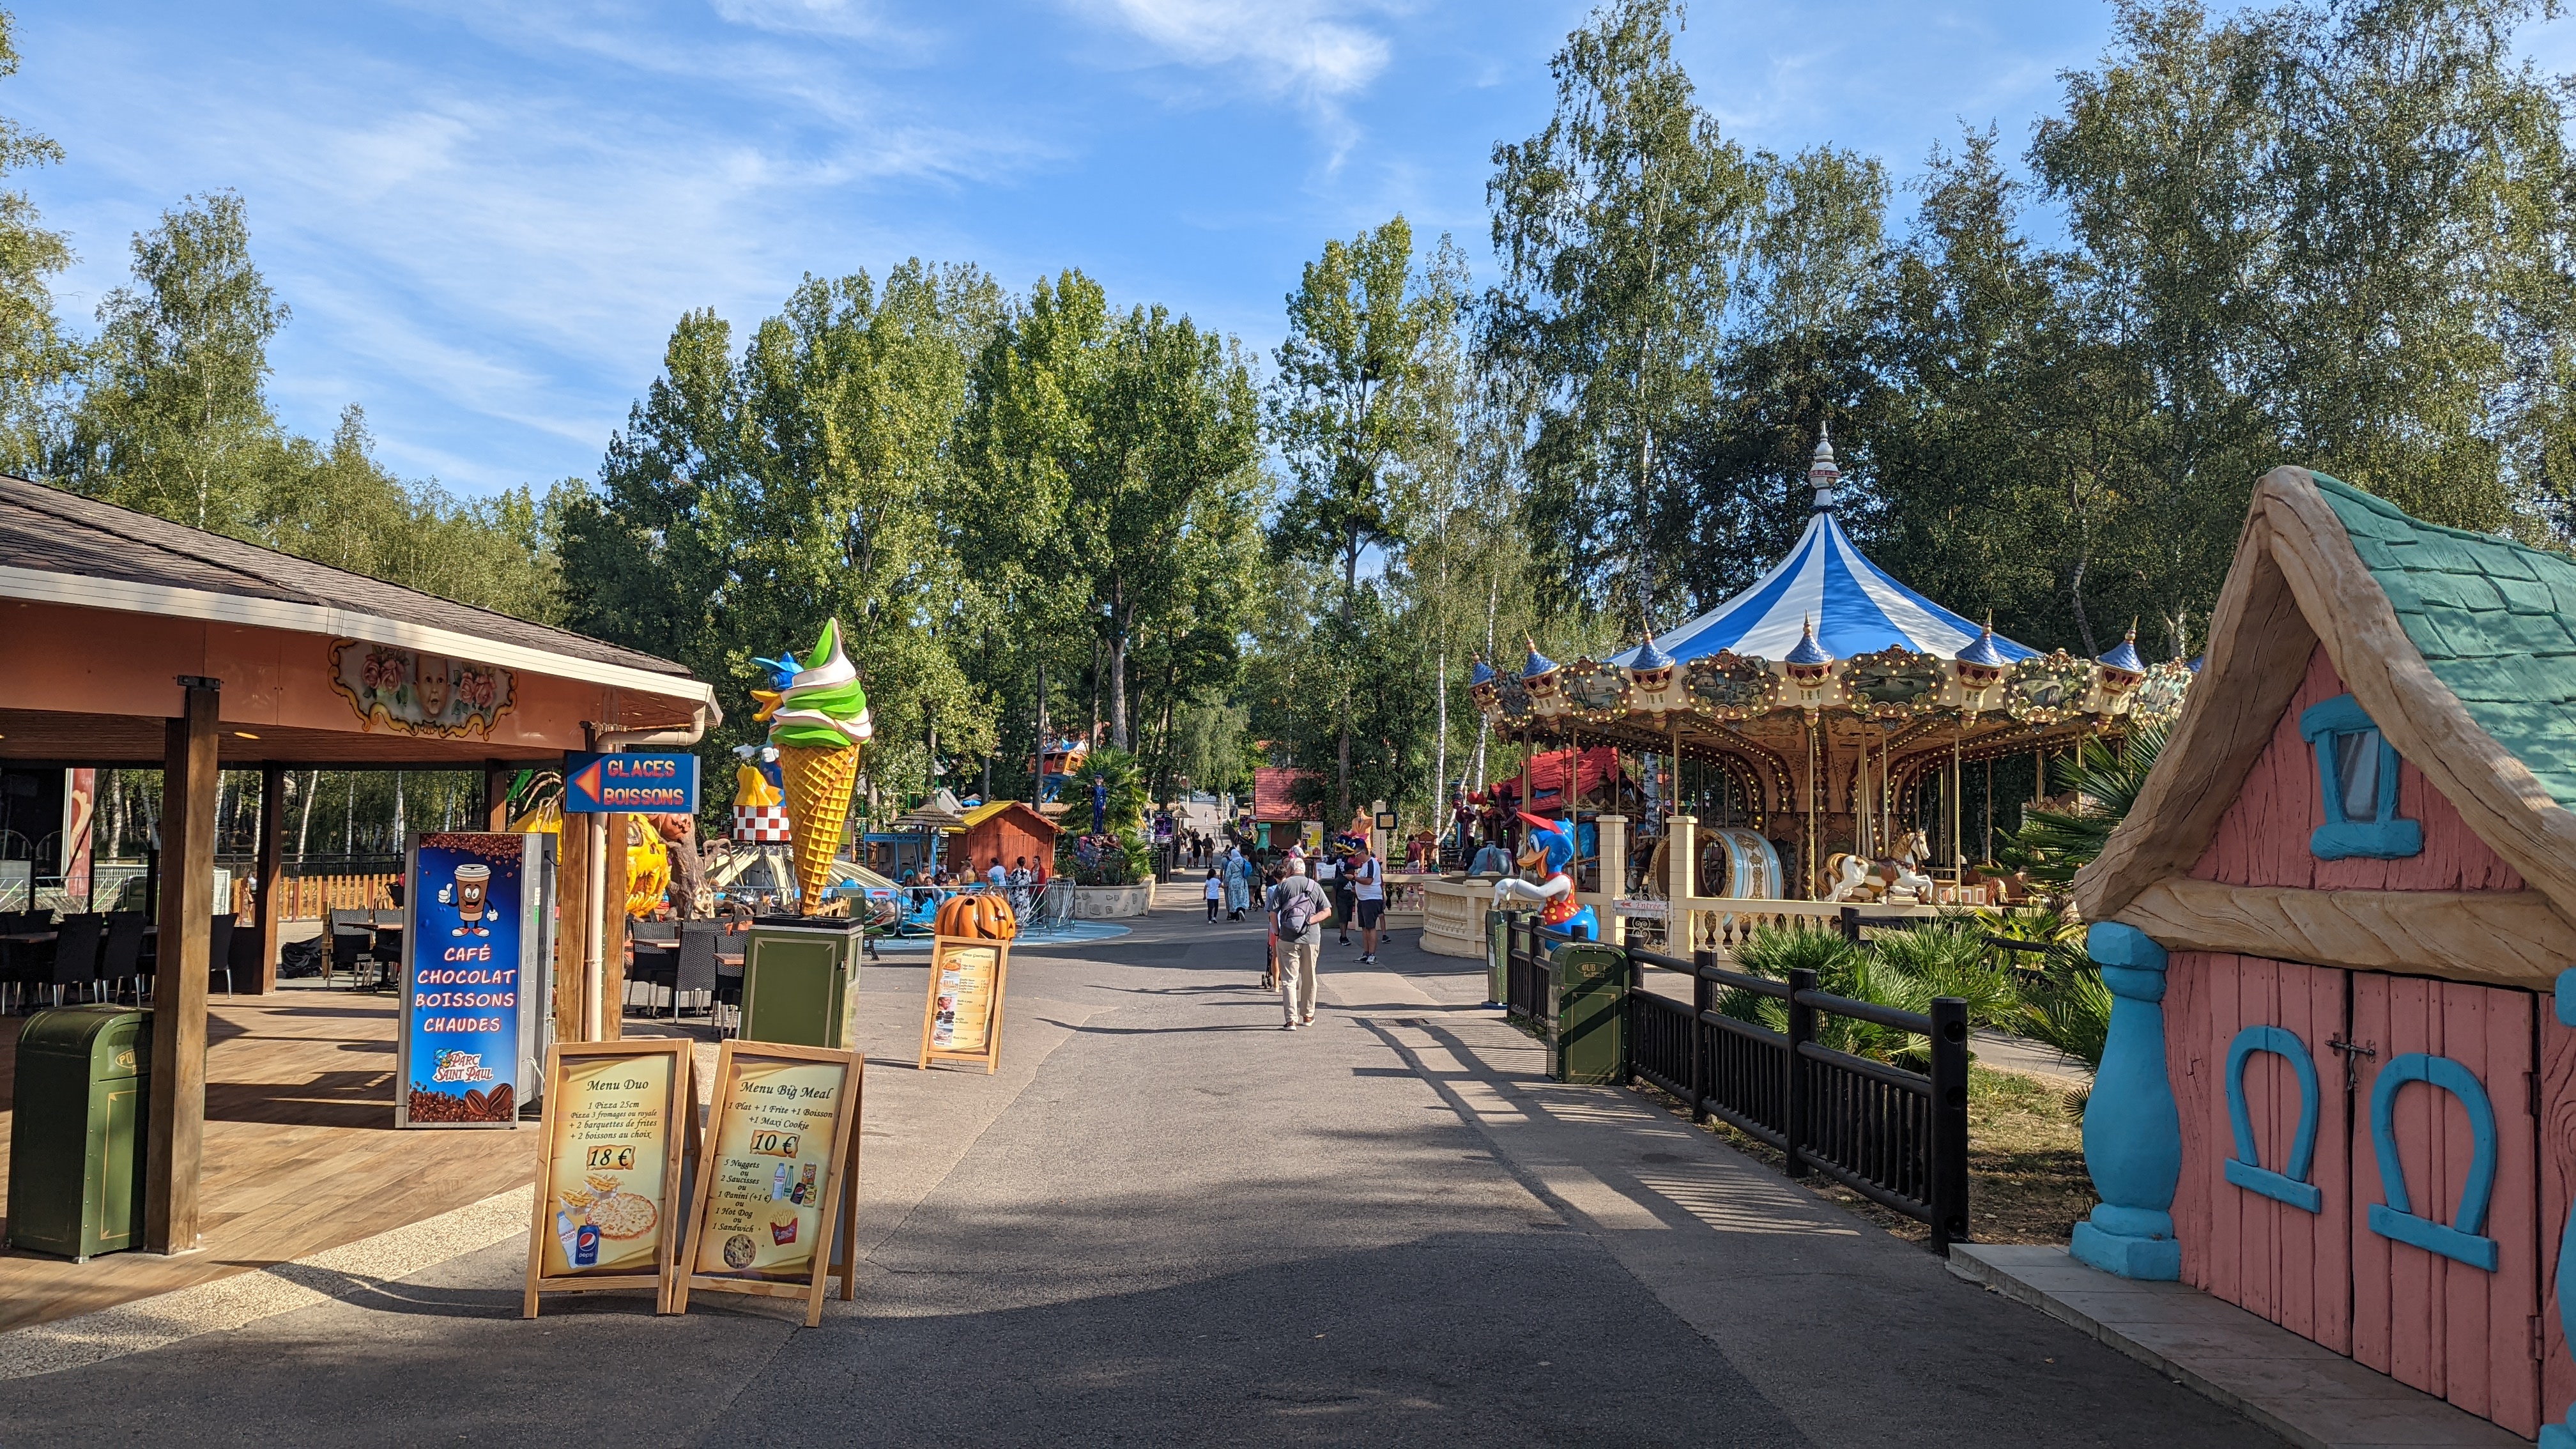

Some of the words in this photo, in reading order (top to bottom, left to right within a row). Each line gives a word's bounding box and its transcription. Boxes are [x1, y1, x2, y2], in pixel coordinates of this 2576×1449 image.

[608, 760, 675, 777] GLACES
[604, 788, 684, 805] BOISSONS
[444, 944, 491, 961] CAFÉ
[417, 969, 516, 984] CHOCOLAT
[415, 992, 514, 1007] BOISSONS
[424, 1017, 501, 1032] CHAUDES
[450, 1052, 480, 1067] PARC
[434, 1066, 464, 1081] SAINT
[465, 1066, 493, 1081] PAUL
[586, 1080, 620, 1091] Menu
[624, 1079, 648, 1089] Duo
[740, 1082, 773, 1094] Menu
[777, 1085, 797, 1100] Big
[800, 1087, 834, 1099] Meal
[595, 1110, 626, 1119] fromages
[638, 1109, 657, 1117] royale
[735, 1101, 751, 1110] Plat
[769, 1105, 788, 1114] Frite
[803, 1108, 832, 1118] Boisson
[584, 1121, 624, 1130] barquettes
[625, 1119, 634, 1127] de
[634, 1119, 657, 1129] frites
[760, 1117, 783, 1128] Maxi
[783, 1120, 809, 1130] Cookie
[631, 1130, 652, 1138] choix
[753, 1133, 777, 1151] 10
[782, 1136, 797, 1154] €
[588, 1149, 612, 1166] 18
[618, 1148, 632, 1167] €
[730, 1160, 760, 1169] Nuggets
[726, 1176, 760, 1184] Saucisses
[724, 1191, 749, 1199] Panini
[749, 1193, 762, 1202] (+1
[764, 1194, 772, 1204] €)
[738, 1209, 753, 1219] Dog
[718, 1223, 754, 1233] Sandwich
